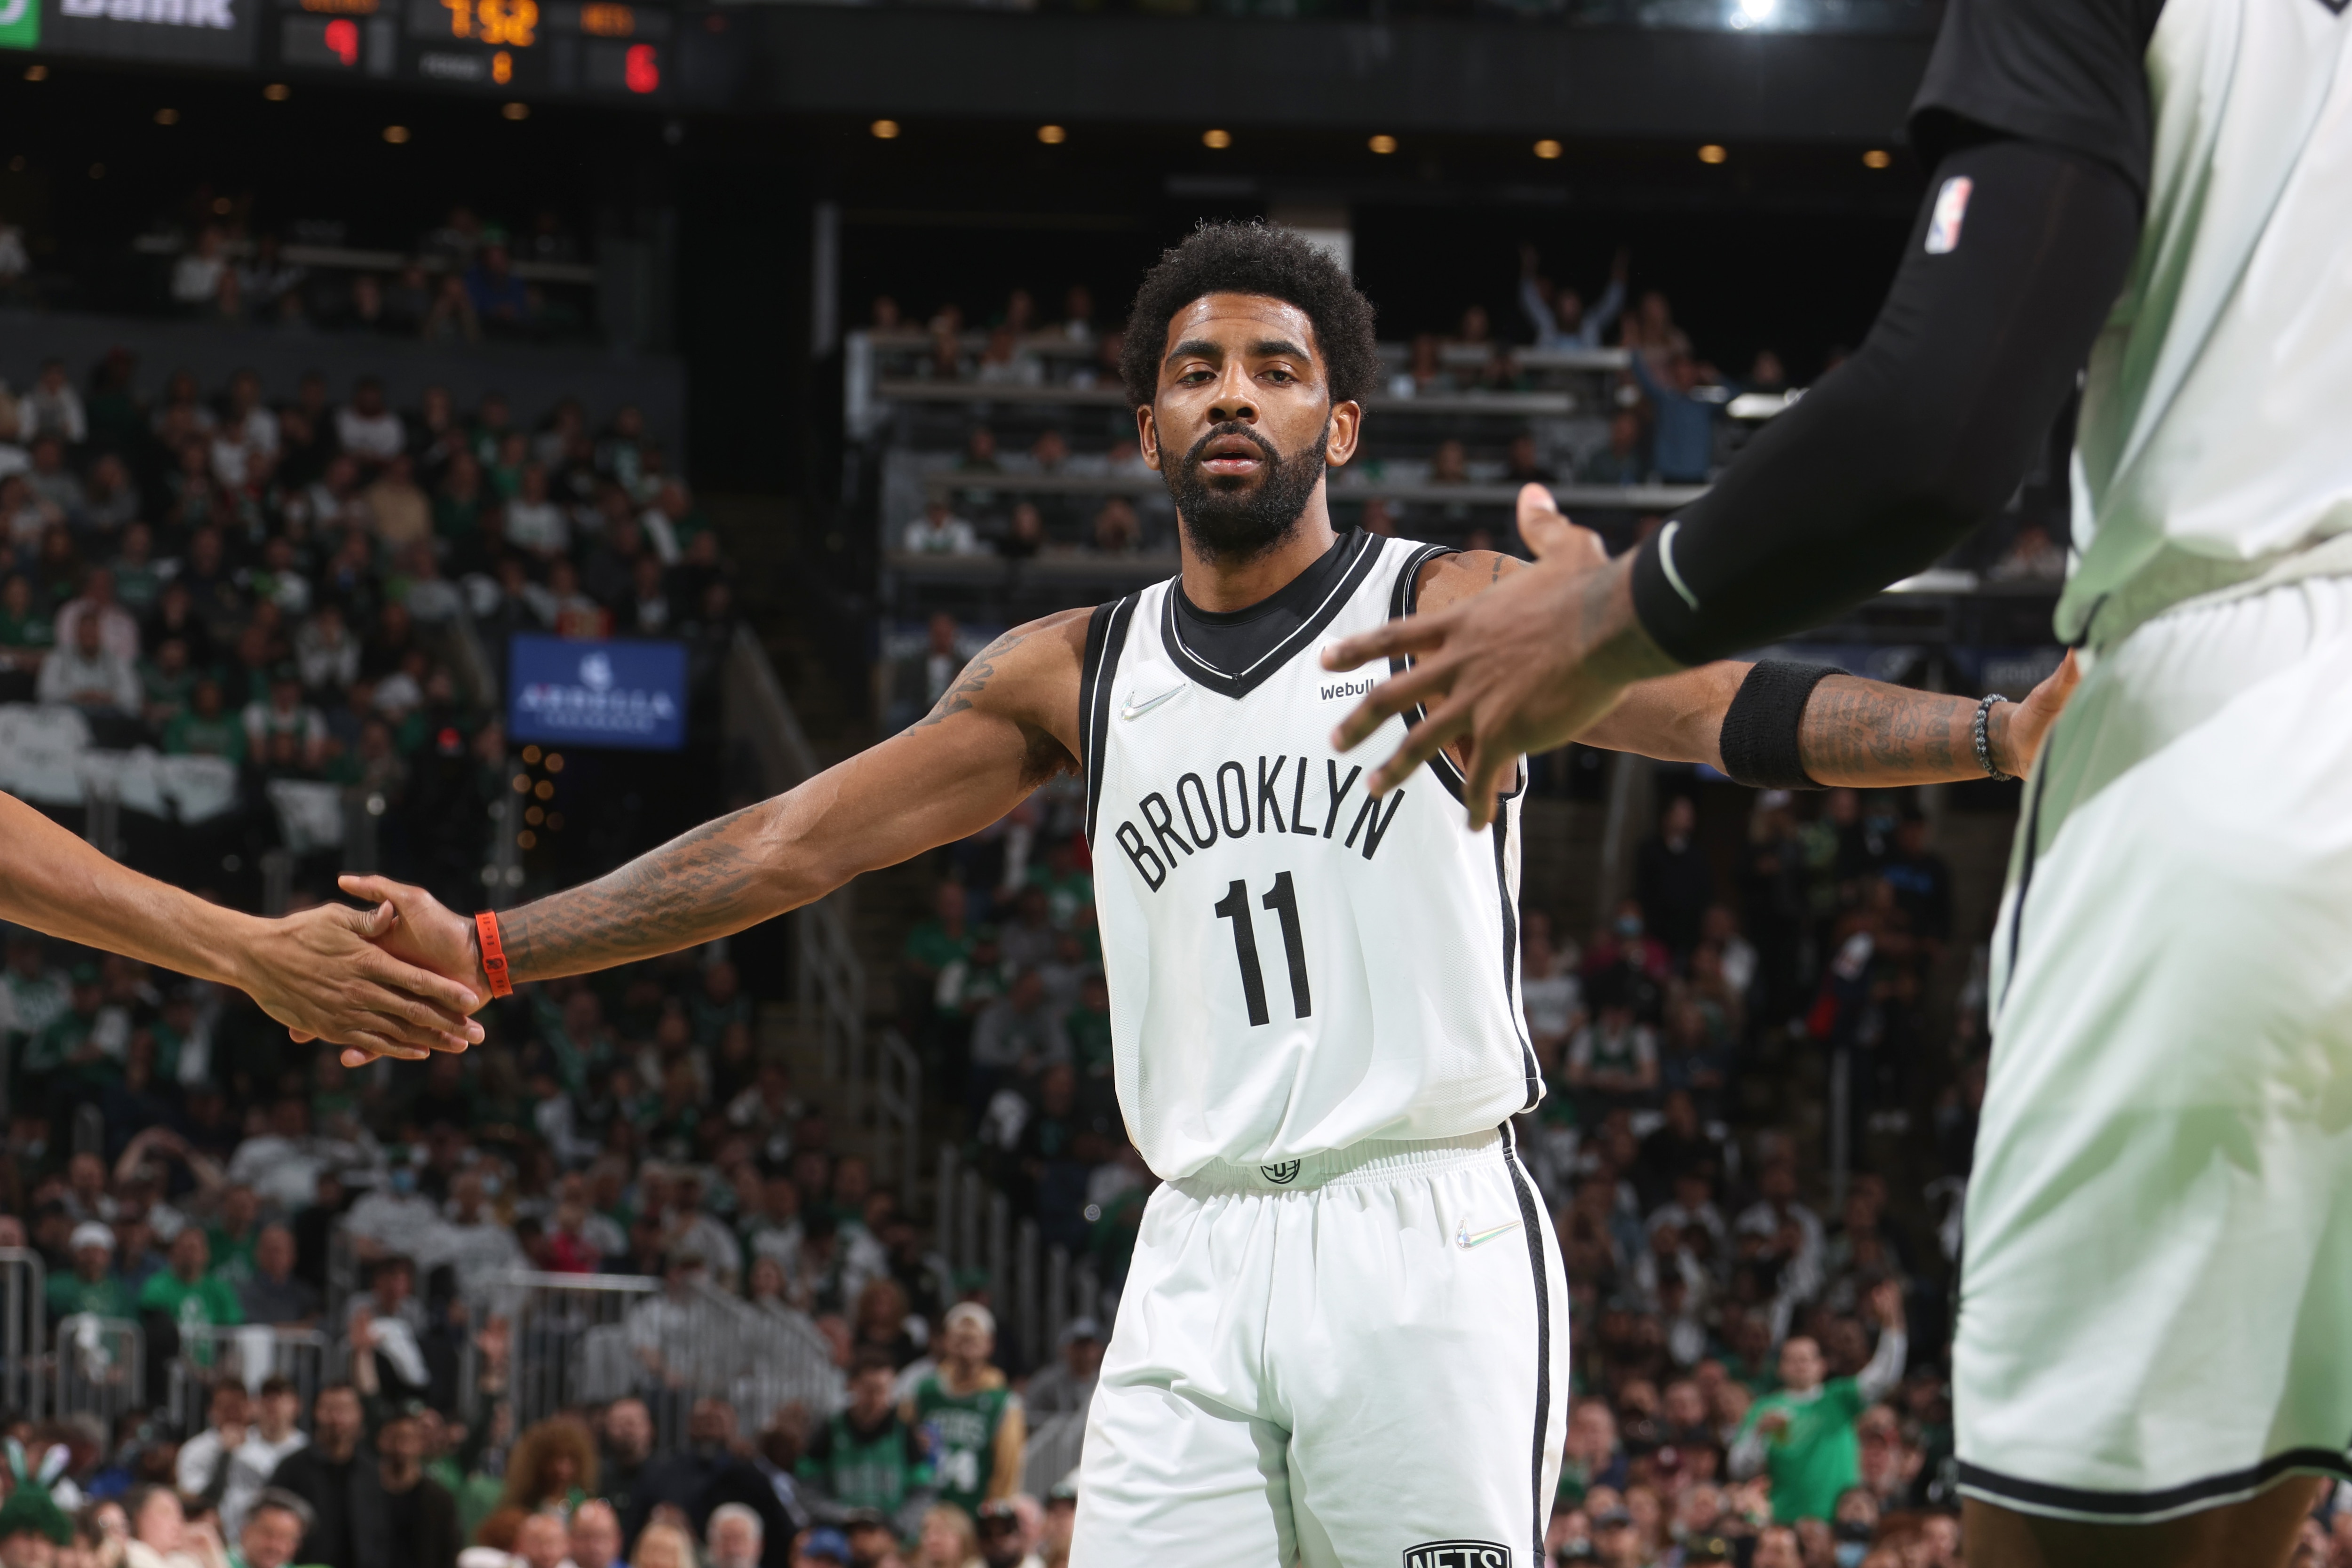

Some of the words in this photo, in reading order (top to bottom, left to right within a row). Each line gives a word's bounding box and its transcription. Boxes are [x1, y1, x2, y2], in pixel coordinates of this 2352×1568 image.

[626, 43, 659, 93] 6
[1321, 678, 1374, 700] Webull
[1115, 755, 1406, 893] BROOKLYN
[1214, 870, 1311, 1027] 11
